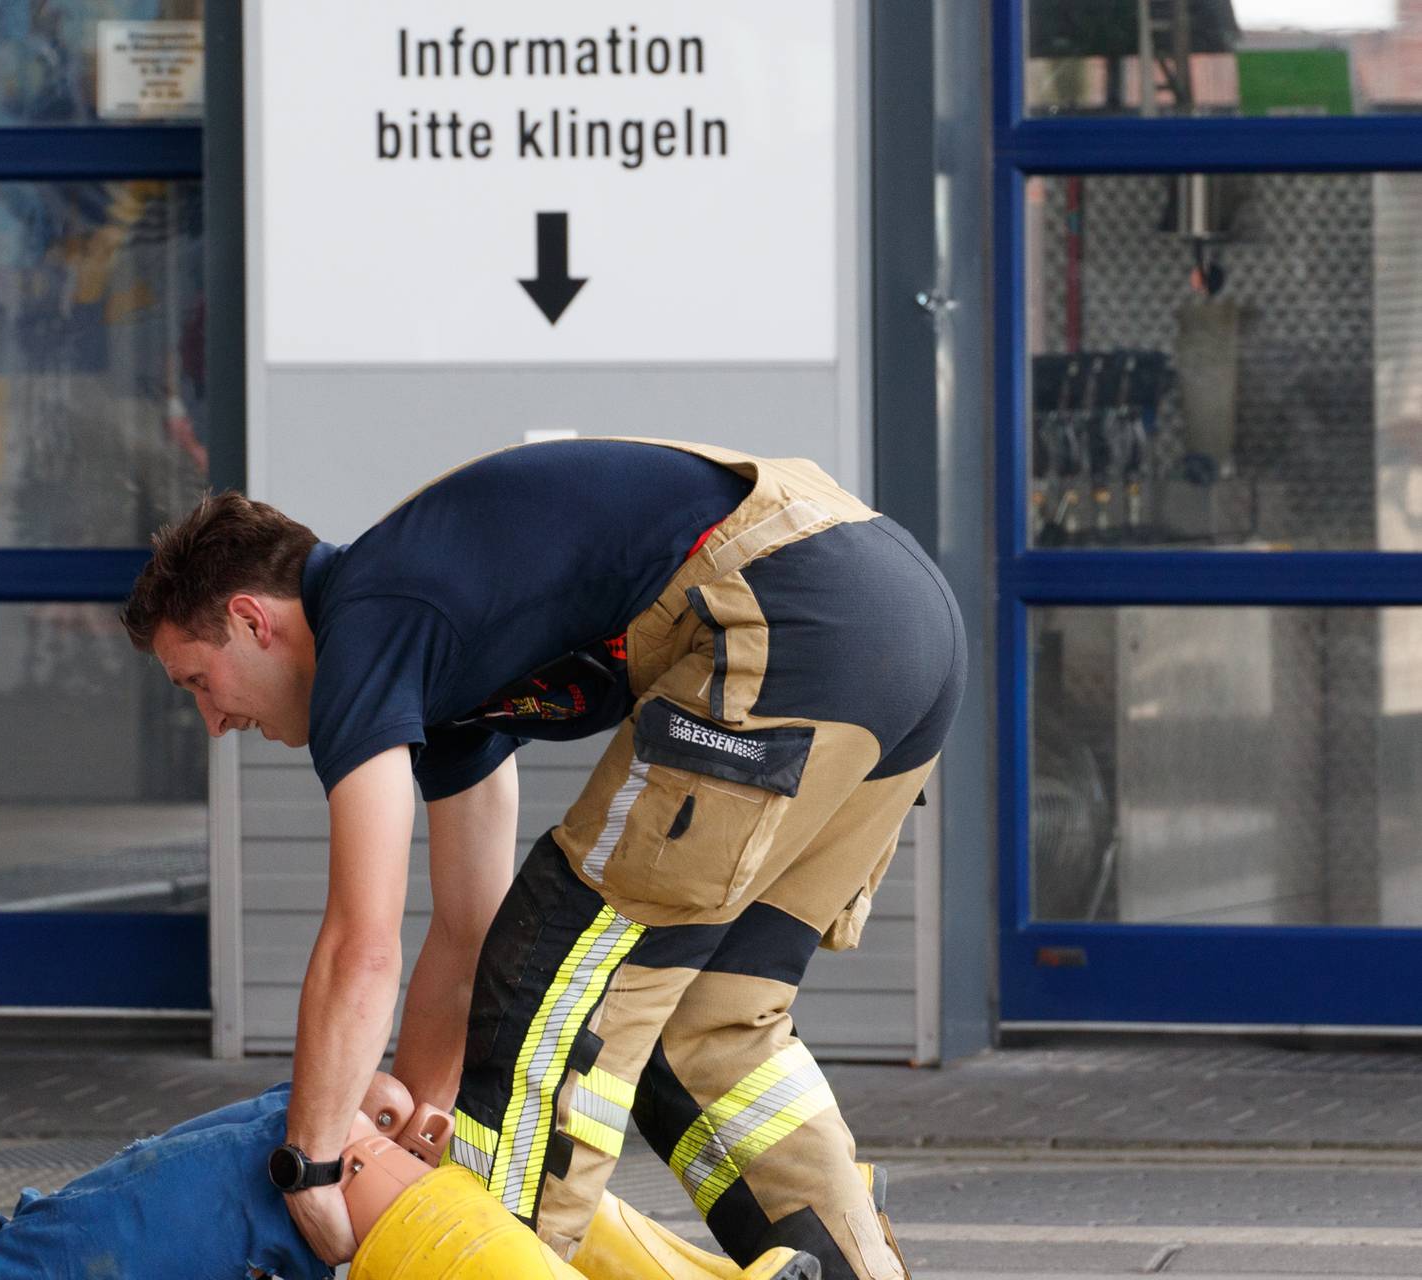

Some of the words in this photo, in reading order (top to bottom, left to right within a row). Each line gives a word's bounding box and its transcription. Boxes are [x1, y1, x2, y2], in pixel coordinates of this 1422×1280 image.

[399, 25, 704, 77] Information
[377, 110, 493, 160] bitte
[518, 108, 727, 169] klingeln
[690, 728, 736, 754] ESSEN
